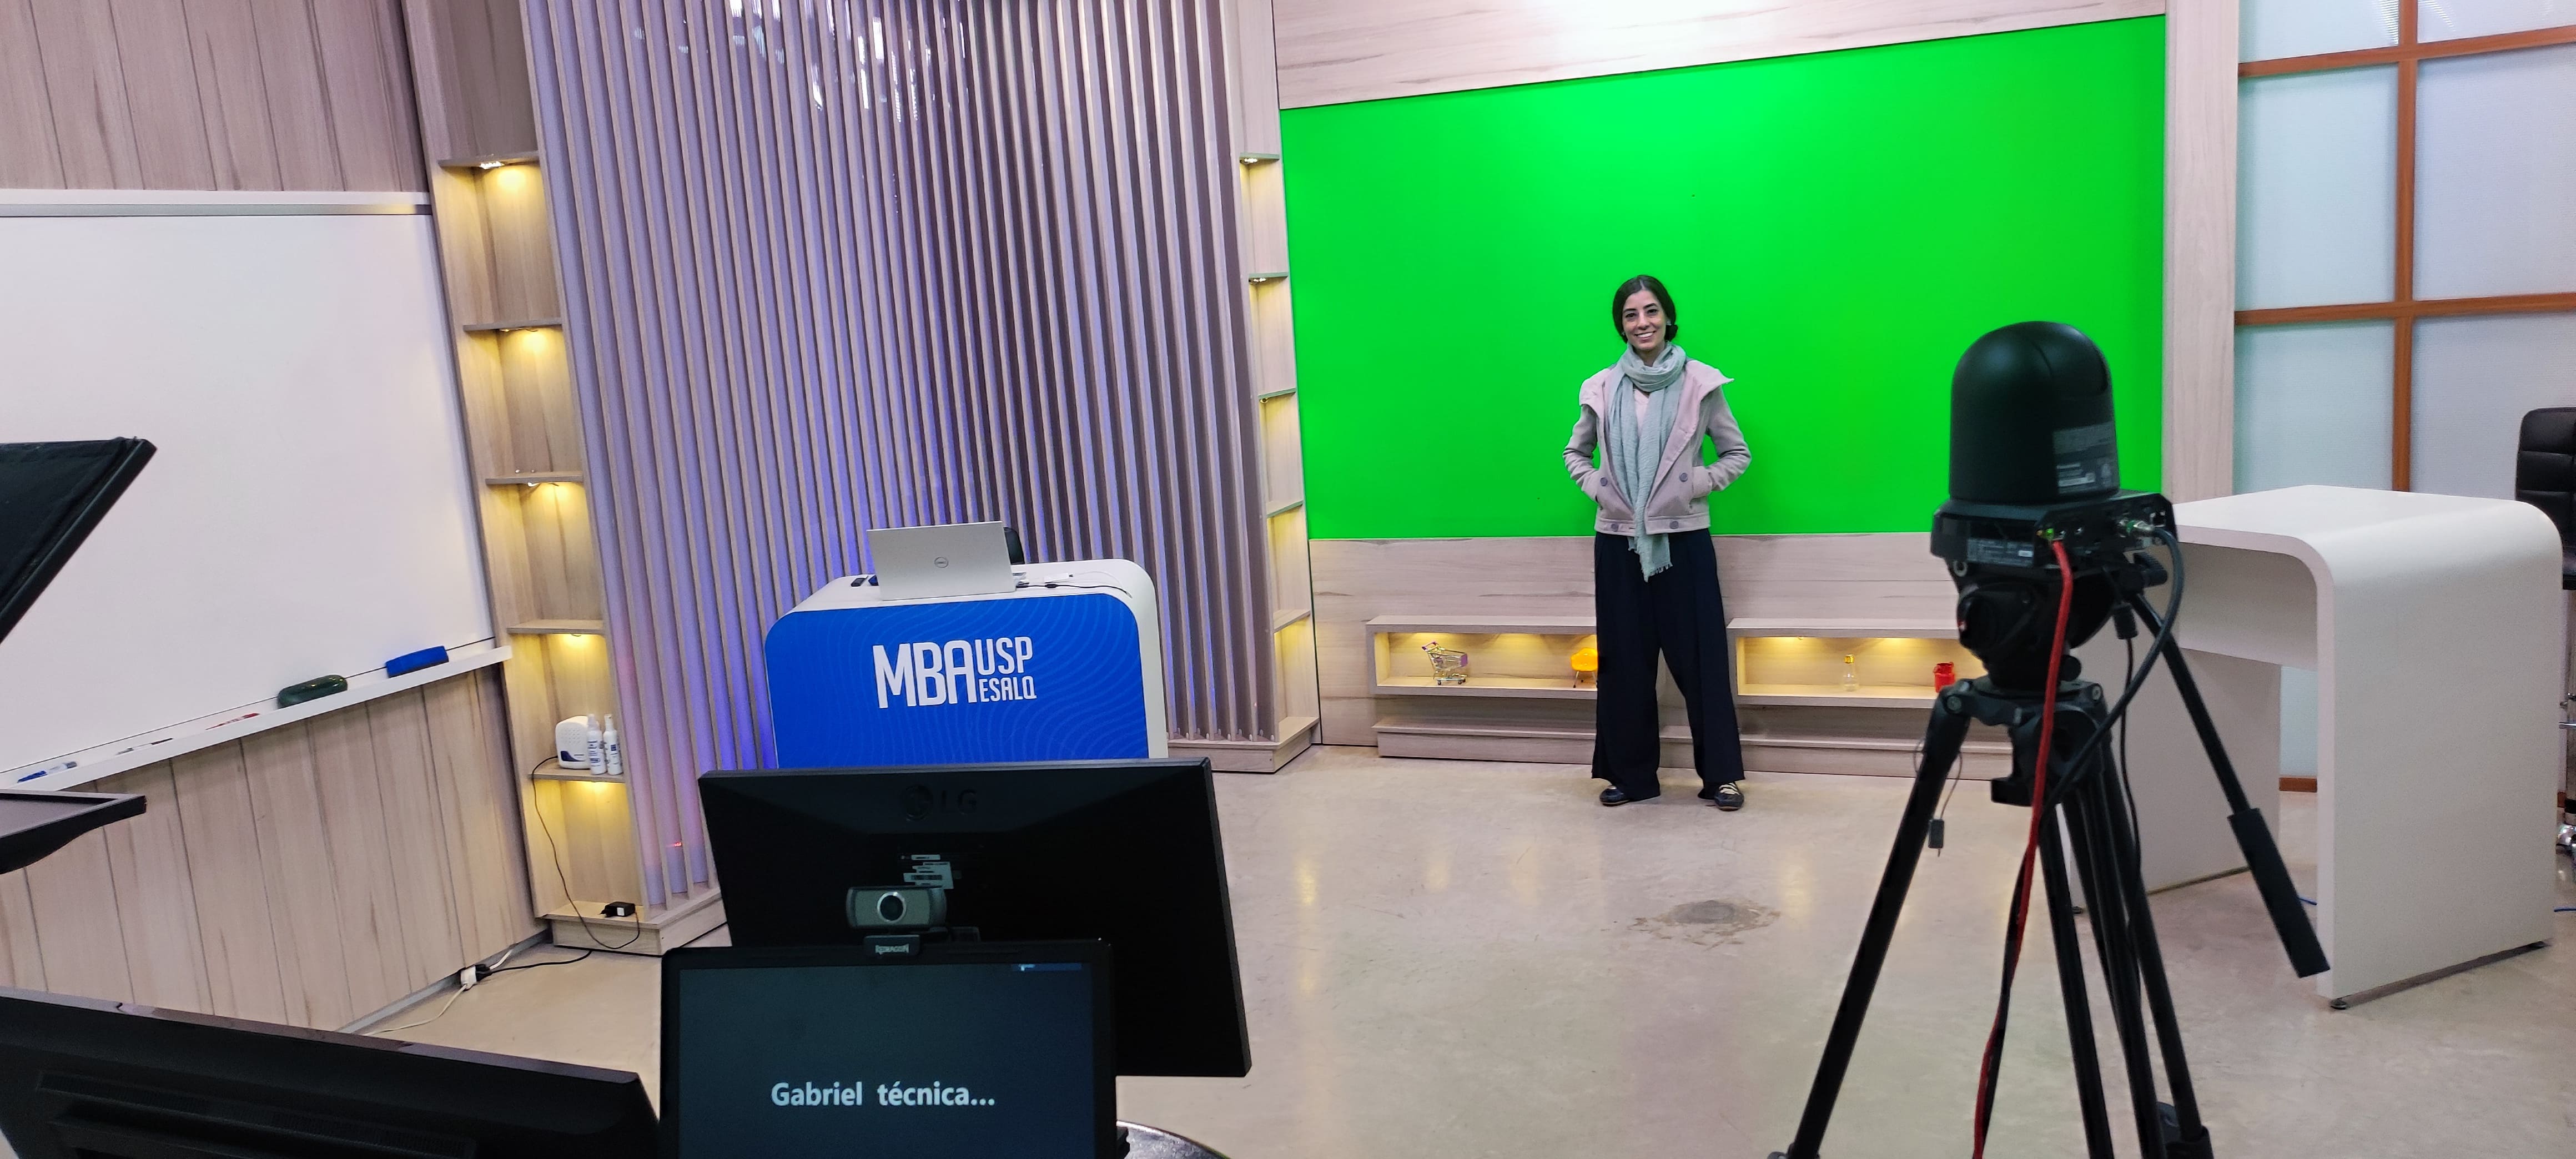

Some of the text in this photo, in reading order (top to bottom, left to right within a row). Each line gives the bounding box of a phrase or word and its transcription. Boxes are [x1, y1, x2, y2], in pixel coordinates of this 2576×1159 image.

[873, 636, 1033, 708] MBA USP
[979, 676, 1037, 702] ESALQ
[940, 789, 978, 815] LG
[771, 1080, 995, 1106] Gabriel técnica...
